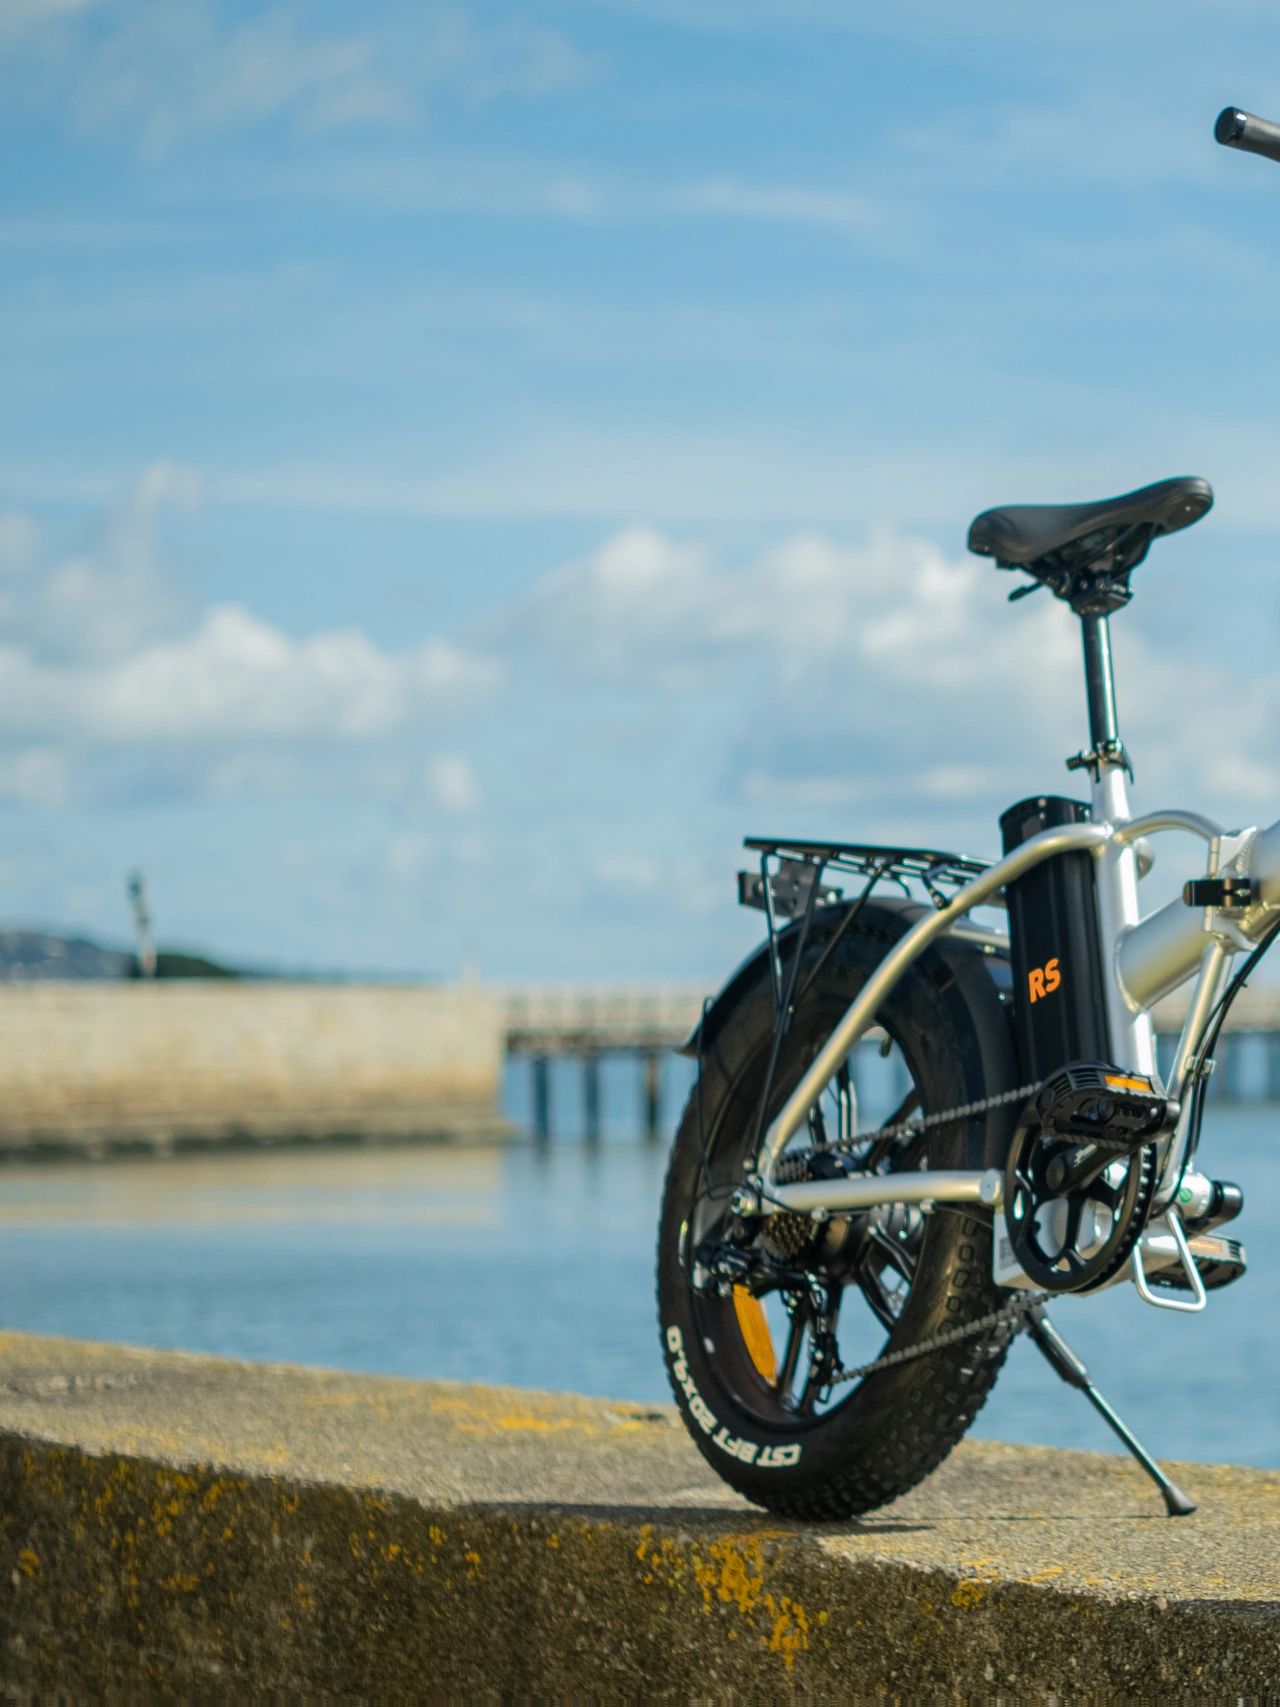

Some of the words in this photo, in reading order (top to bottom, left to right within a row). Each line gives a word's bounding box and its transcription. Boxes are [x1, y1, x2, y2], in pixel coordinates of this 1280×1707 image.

[1028, 958, 1062, 1003] RS
[712, 1427, 758, 1464] BFT
[757, 1443, 802, 1467] CST
